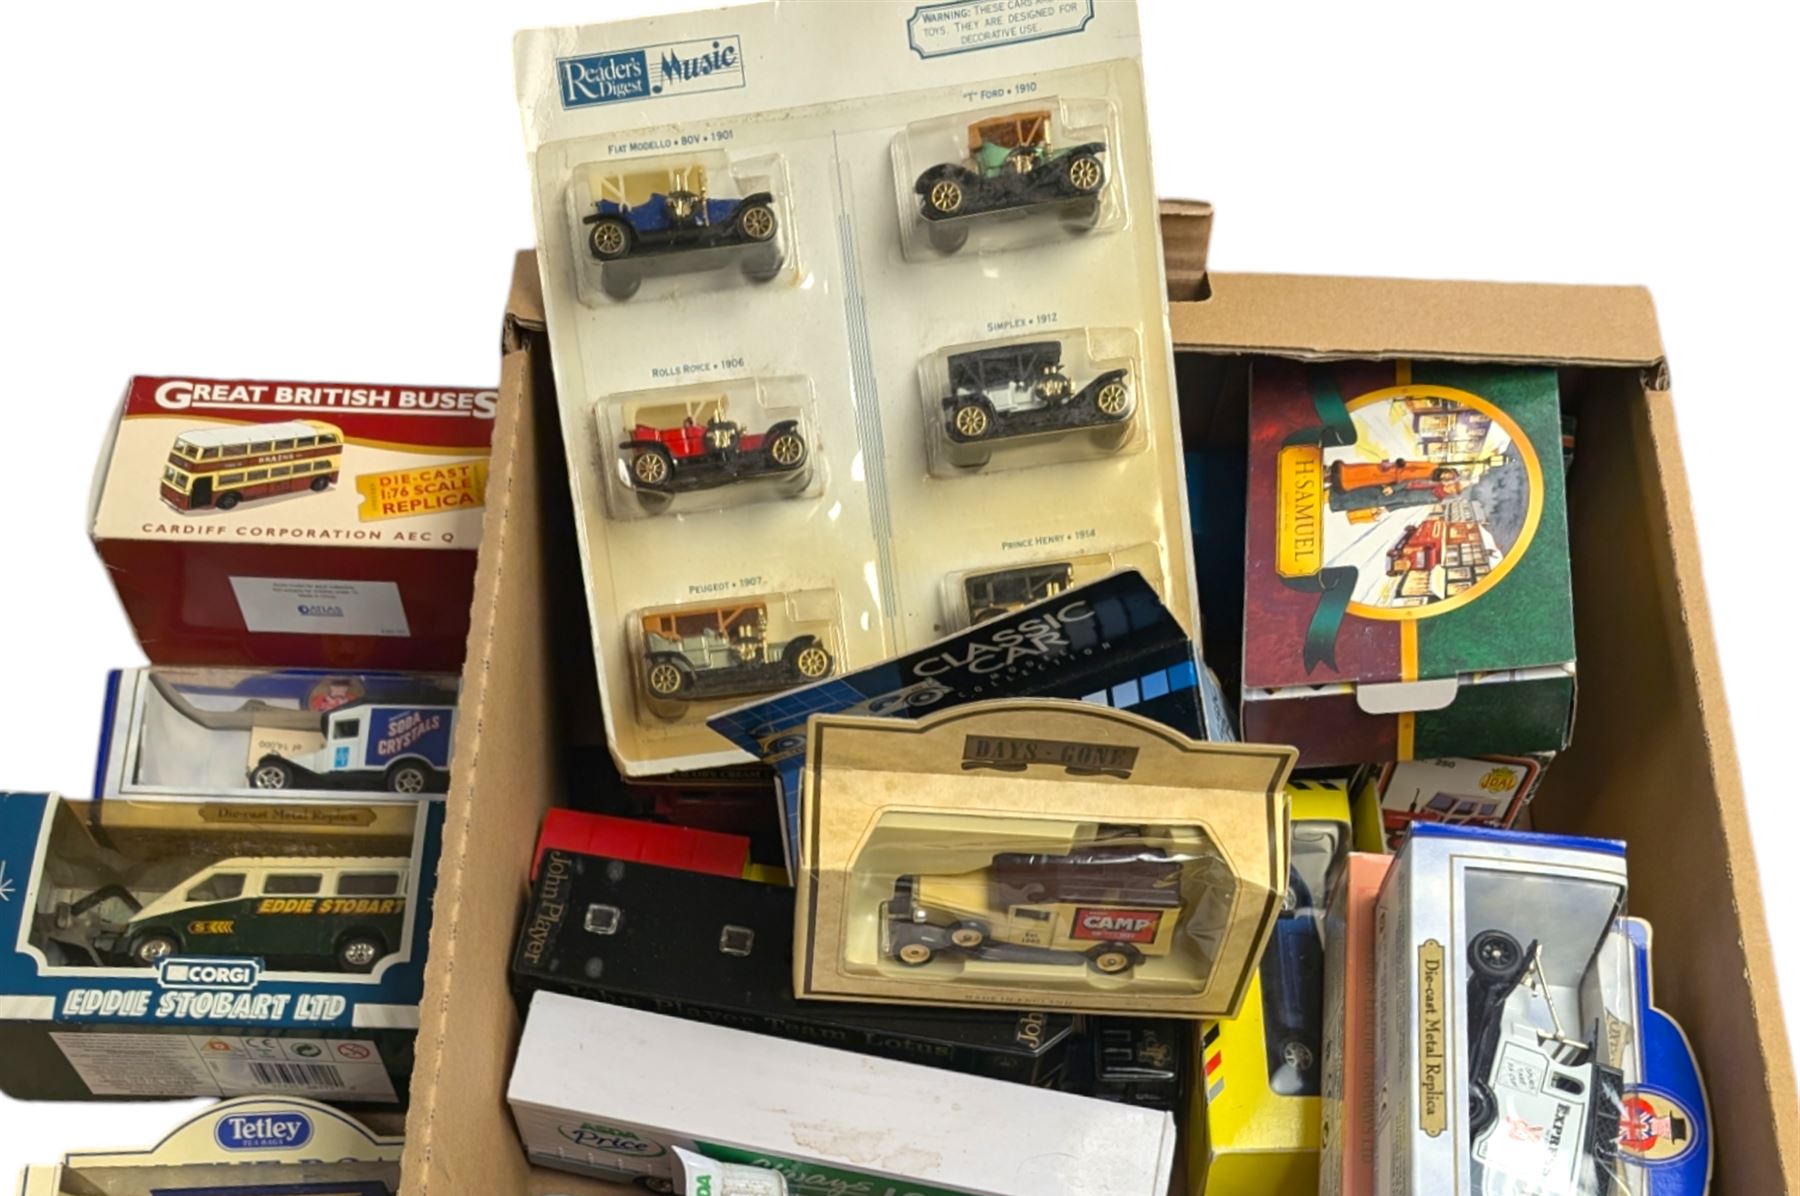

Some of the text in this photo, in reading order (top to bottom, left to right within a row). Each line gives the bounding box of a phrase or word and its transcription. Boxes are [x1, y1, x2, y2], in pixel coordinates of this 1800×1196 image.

[956, 21, 979, 33] THEY
[985, 16, 1003, 27] ARE
[1008, 7, 1056, 24] DESIGNED
[1059, 3, 1078, 14] FOR
[975, 3, 1001, 15] THESE
[961, 24, 1042, 45] DECORATIVE USE.
[652, 41, 737, 93] Music
[564, 57, 642, 101] Reader's
[599, 80, 643, 98] Digest
[980, 89, 1004, 100] FORD
[1015, 82, 1037, 94] 1910
[608, 143, 627, 155] FIAT
[711, 129, 734, 141] 1901
[986, 311, 1058, 332] SIMPLEX 1912
[652, 358, 745, 379] ROLLS ROYCE 1906
[154, 380, 499, 419] GREAT BRITISH BUSES
[379, 466, 471, 487] DIE-CAST
[381, 479, 472, 500] 1:76 SCALE
[382, 492, 475, 515] REPLICA
[142, 523, 455, 544] CARDIFF CORPORATION AEC Q
[1001, 528, 1096, 551] PRINCE HENRY 1914
[688, 576, 764, 595] PEUGEOT 1907
[913, 600, 1095, 676] CLASSIC
[968, 630, 1069, 674] CAR
[378, 715, 440, 756] CRYSTALS
[388, 712, 422, 737] SODA
[976, 739, 1038, 761] DAYS
[257, 899, 406, 915] EDDIE STOBART
[524, 851, 572, 964] John Player
[1083, 915, 1149, 932] CAMP
[188, 966, 250, 984] CORGI
[62, 989, 347, 1021] EDDIE STOBART LTD
[1422, 959, 1444, 1115] Die-cast Metal Replica
[229, 1118, 302, 1141] Tetley
[573, 1130, 649, 1151] Price
[580, 1122, 640, 1141] ASDA
